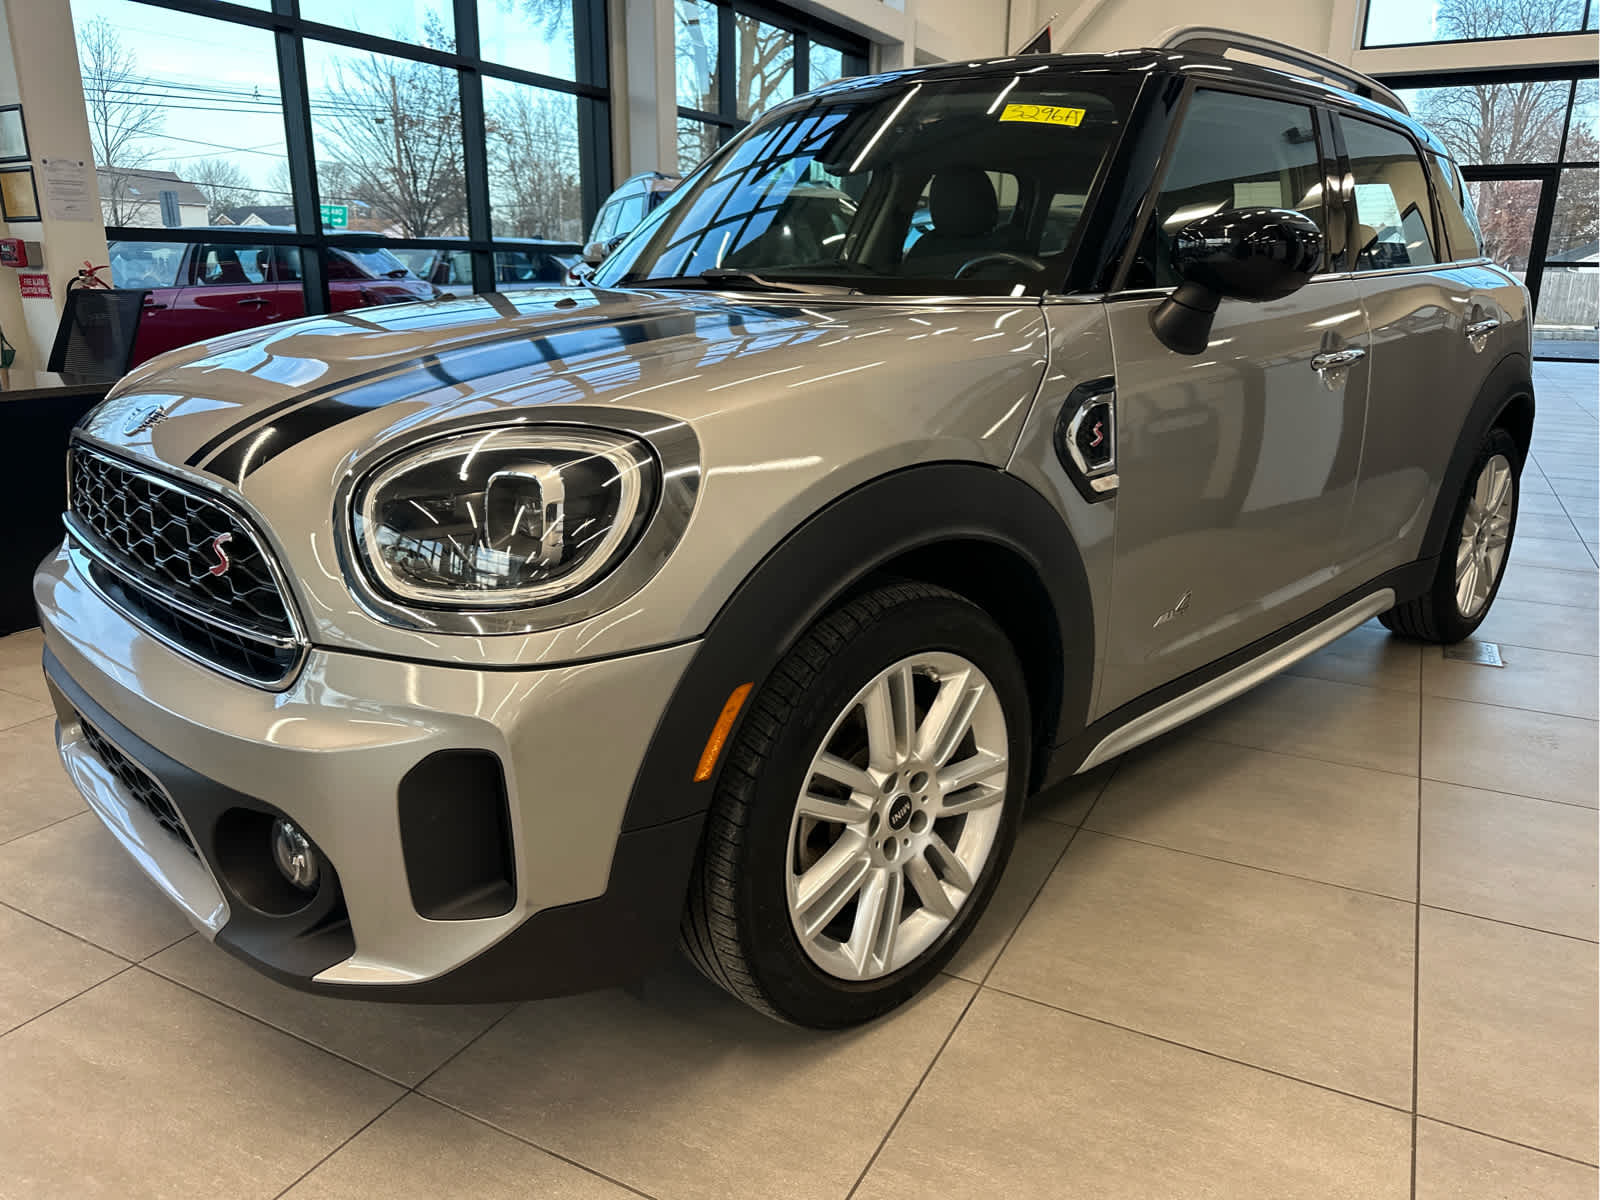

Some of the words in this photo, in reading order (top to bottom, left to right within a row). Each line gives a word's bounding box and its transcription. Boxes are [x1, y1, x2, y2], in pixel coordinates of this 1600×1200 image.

[1089, 421, 1104, 447] S
[209, 532, 232, 576] S
[891, 802, 910, 825] MINI
